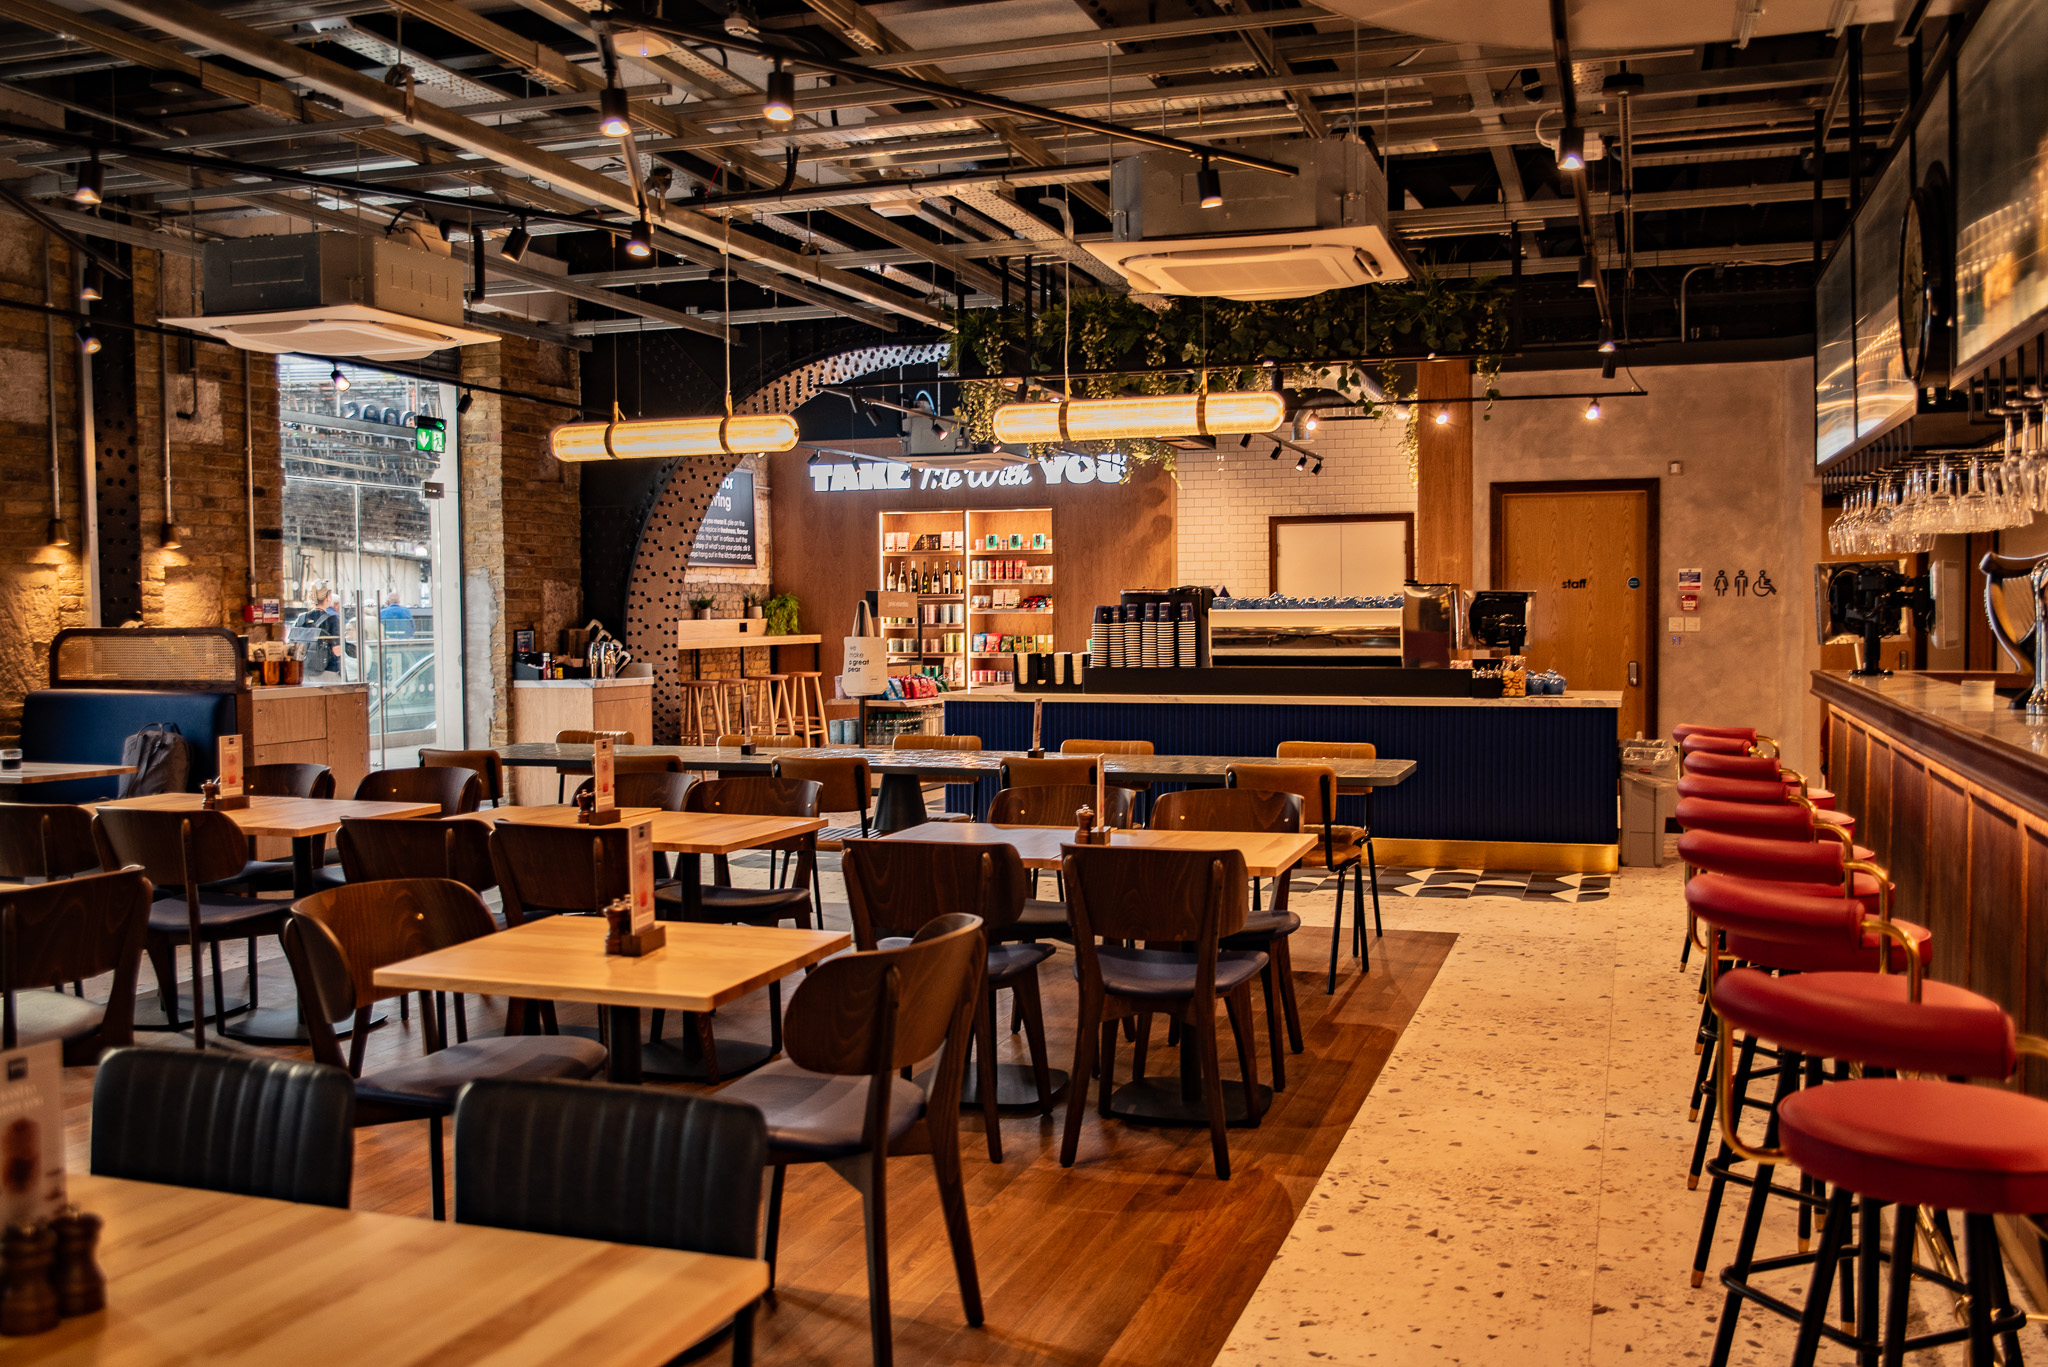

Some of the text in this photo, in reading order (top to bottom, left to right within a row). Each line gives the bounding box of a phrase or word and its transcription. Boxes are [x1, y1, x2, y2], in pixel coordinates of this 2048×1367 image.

[809, 462, 911, 492] TAKE
[1038, 453, 1127, 485] YOU
[1562, 578, 1587, 589] staff
